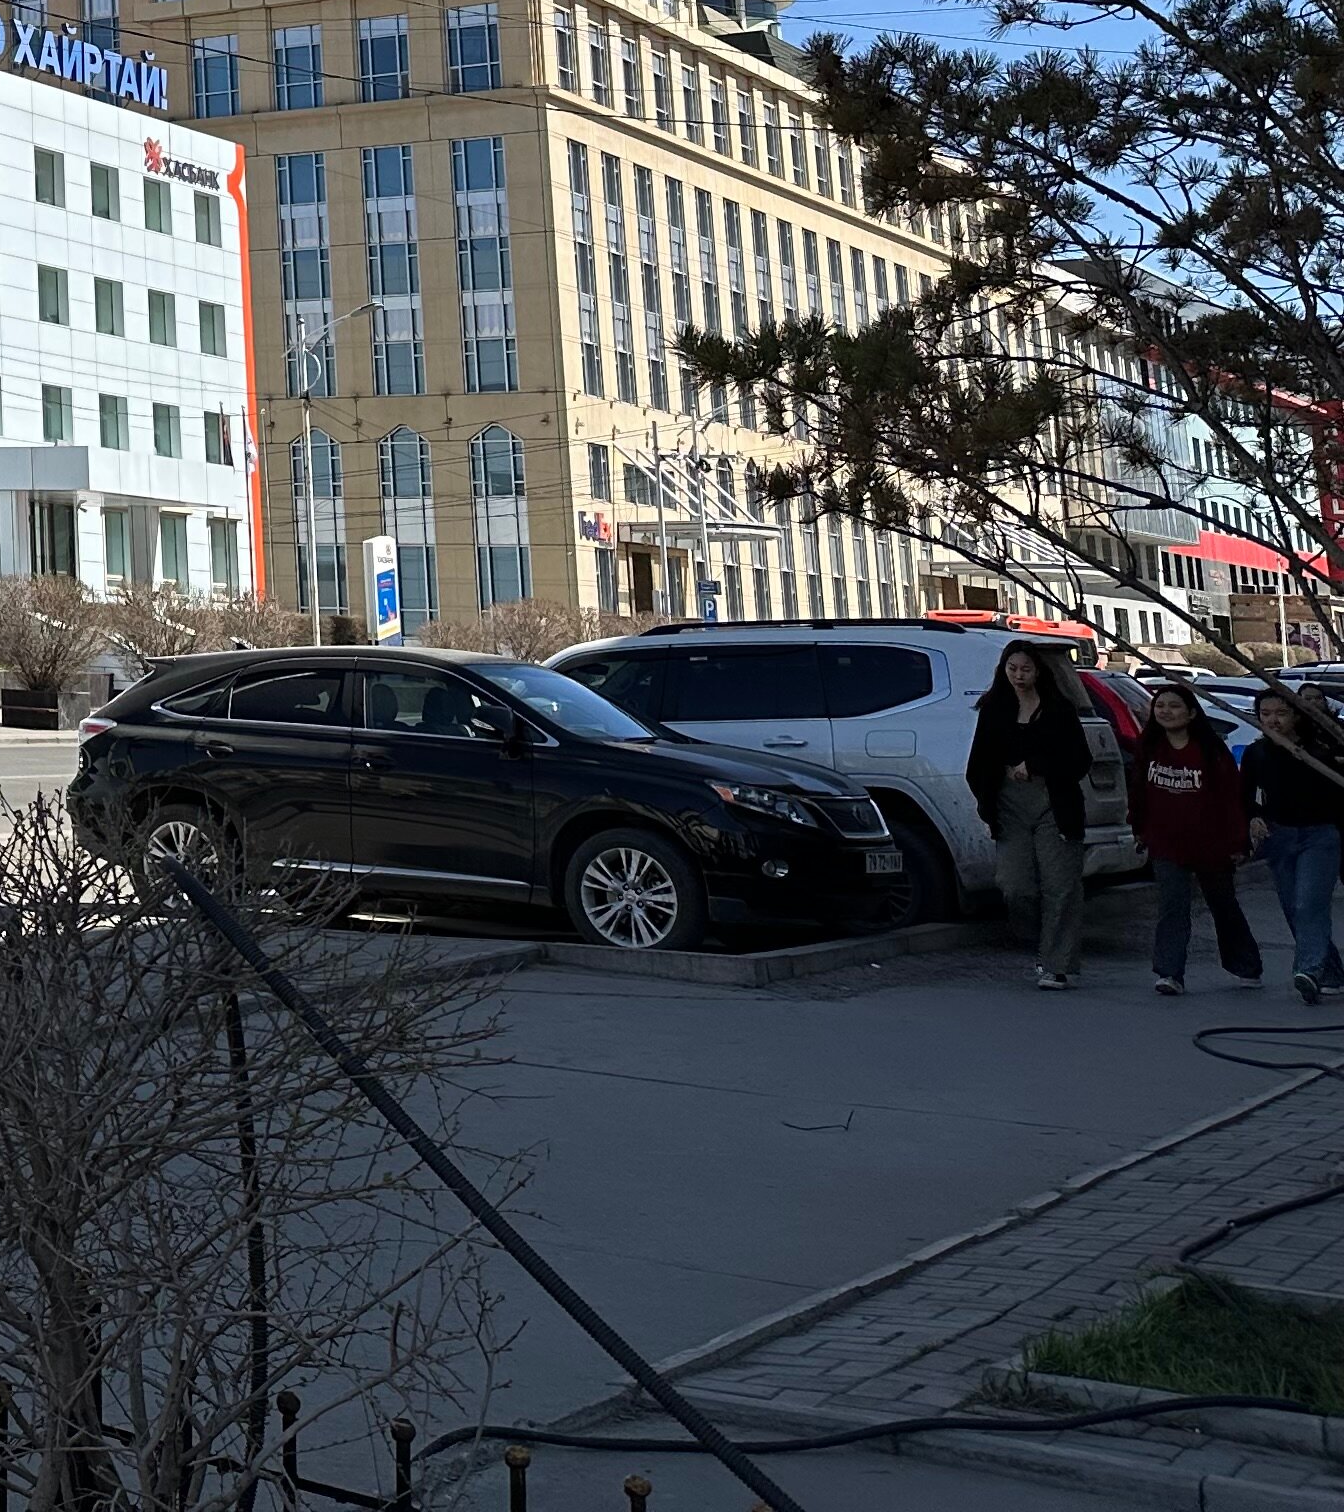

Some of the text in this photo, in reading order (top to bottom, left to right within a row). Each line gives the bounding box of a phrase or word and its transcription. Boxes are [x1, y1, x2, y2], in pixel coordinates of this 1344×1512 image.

[13, 18, 168, 111] ХАЙРТАЙ!
[161, 156, 220, 191] ХАСБАНК
[705, 599, 715, 617] P
